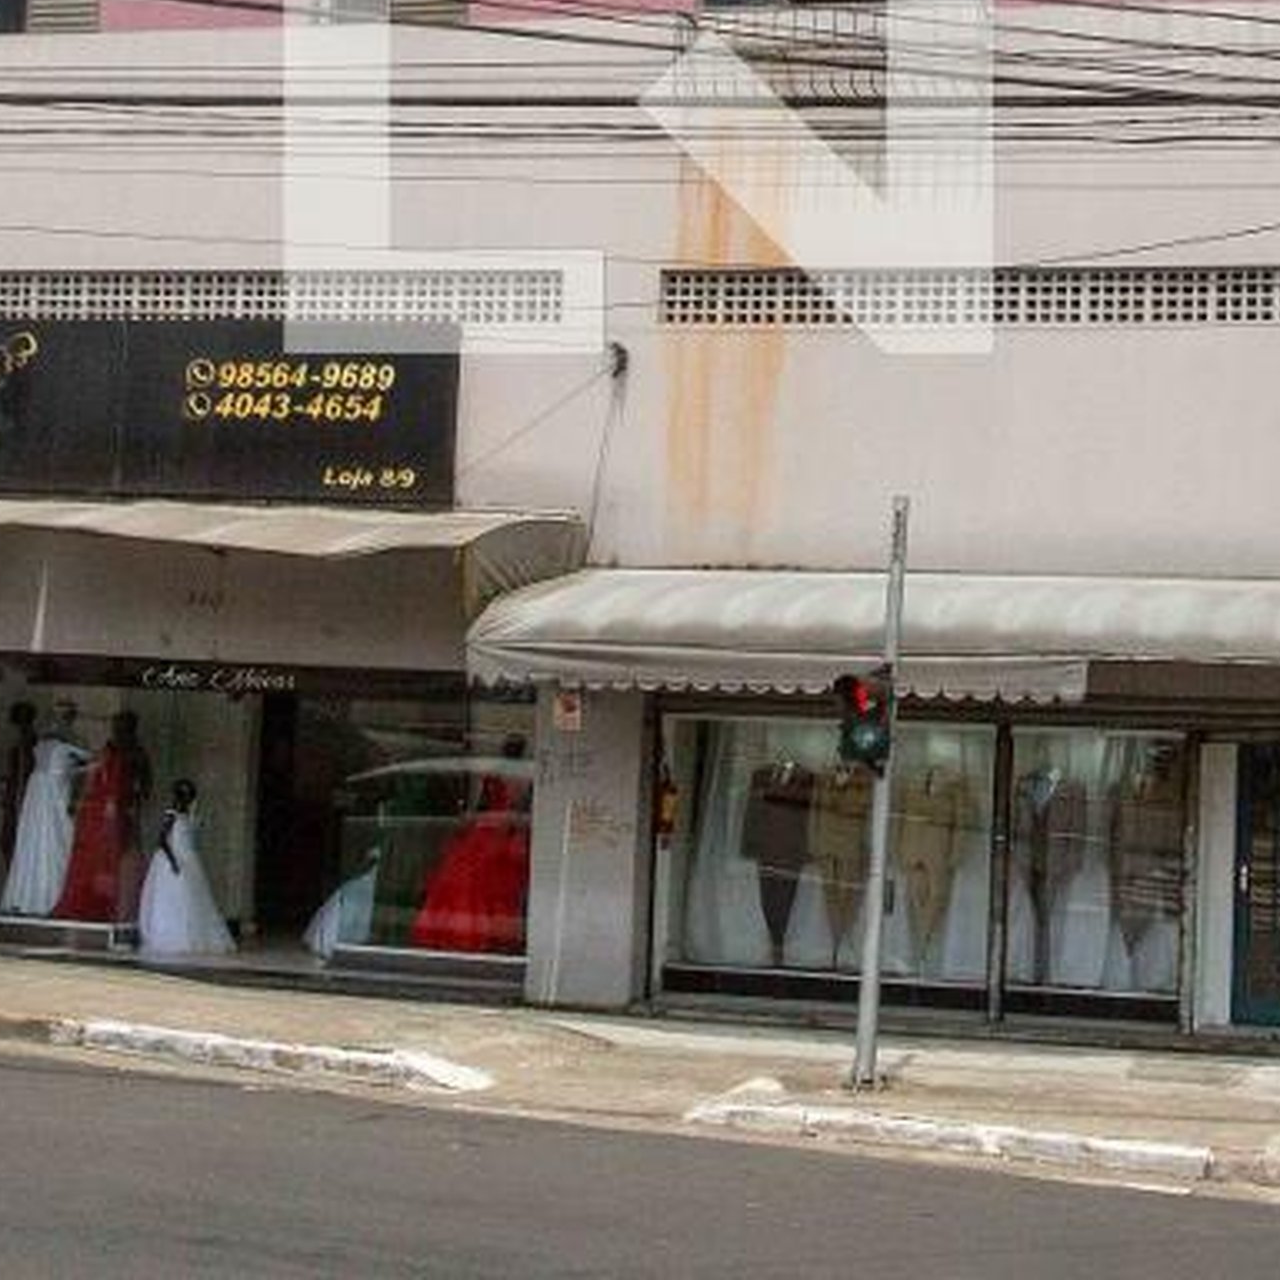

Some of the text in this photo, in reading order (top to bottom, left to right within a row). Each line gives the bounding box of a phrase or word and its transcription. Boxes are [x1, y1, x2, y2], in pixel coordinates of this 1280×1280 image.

[219, 361, 396, 391] 98564-9689
[214, 392, 384, 421] 4043-4654
[323, 468, 371, 489] Loja
